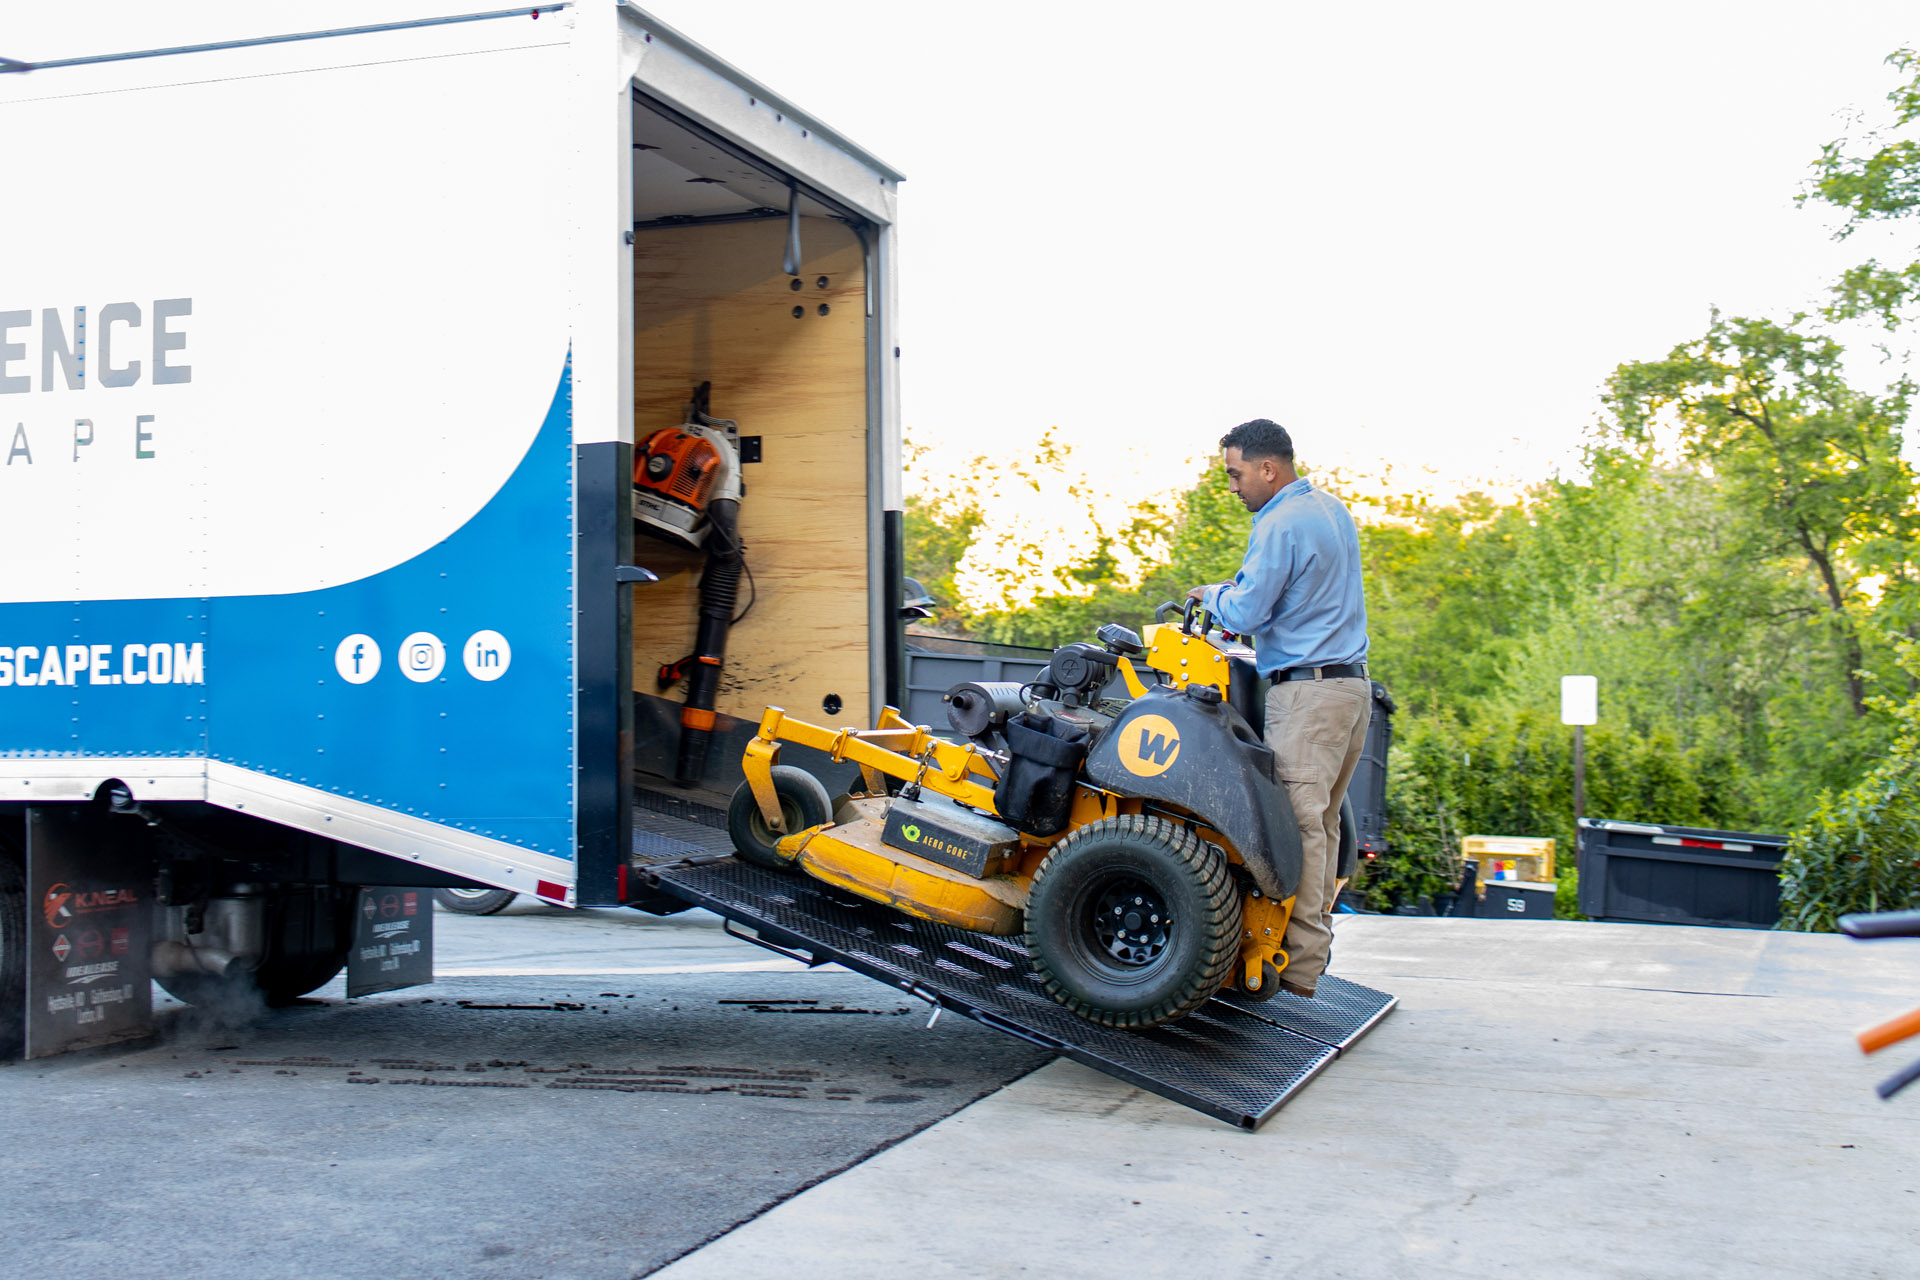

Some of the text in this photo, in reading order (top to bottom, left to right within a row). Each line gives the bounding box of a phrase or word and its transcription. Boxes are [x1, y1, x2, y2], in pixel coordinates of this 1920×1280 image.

[0, 297, 192, 394] ENCE
[0, 642, 204, 686] SCAPE.COM
[1138, 728, 1181, 767] W
[922, 835, 969, 860] AERO CORE
